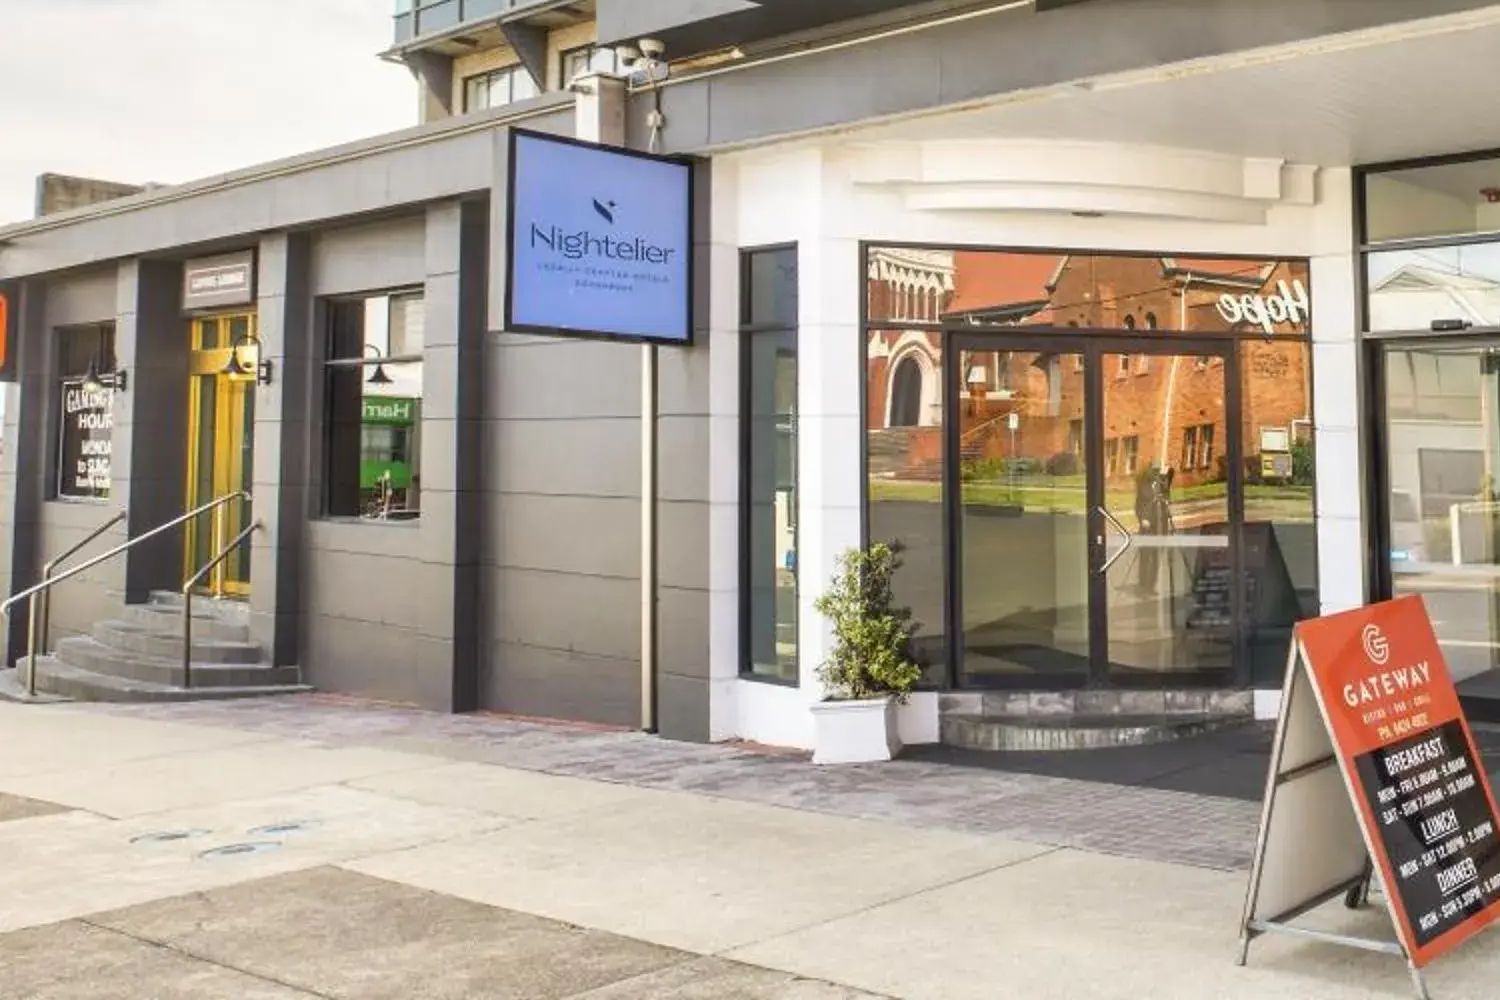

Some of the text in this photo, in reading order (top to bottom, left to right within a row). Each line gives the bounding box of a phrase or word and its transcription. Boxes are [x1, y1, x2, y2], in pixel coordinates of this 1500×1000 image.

[531, 222, 676, 264] Nightelier
[1343, 659, 1431, 708] GATEWAY
[1384, 736, 1445, 776] BREAKFAST
[1382, 807, 1398, 825] SAT
[1420, 807, 1460, 840] LUNCH
[1436, 857, 1478, 892] DINNER
